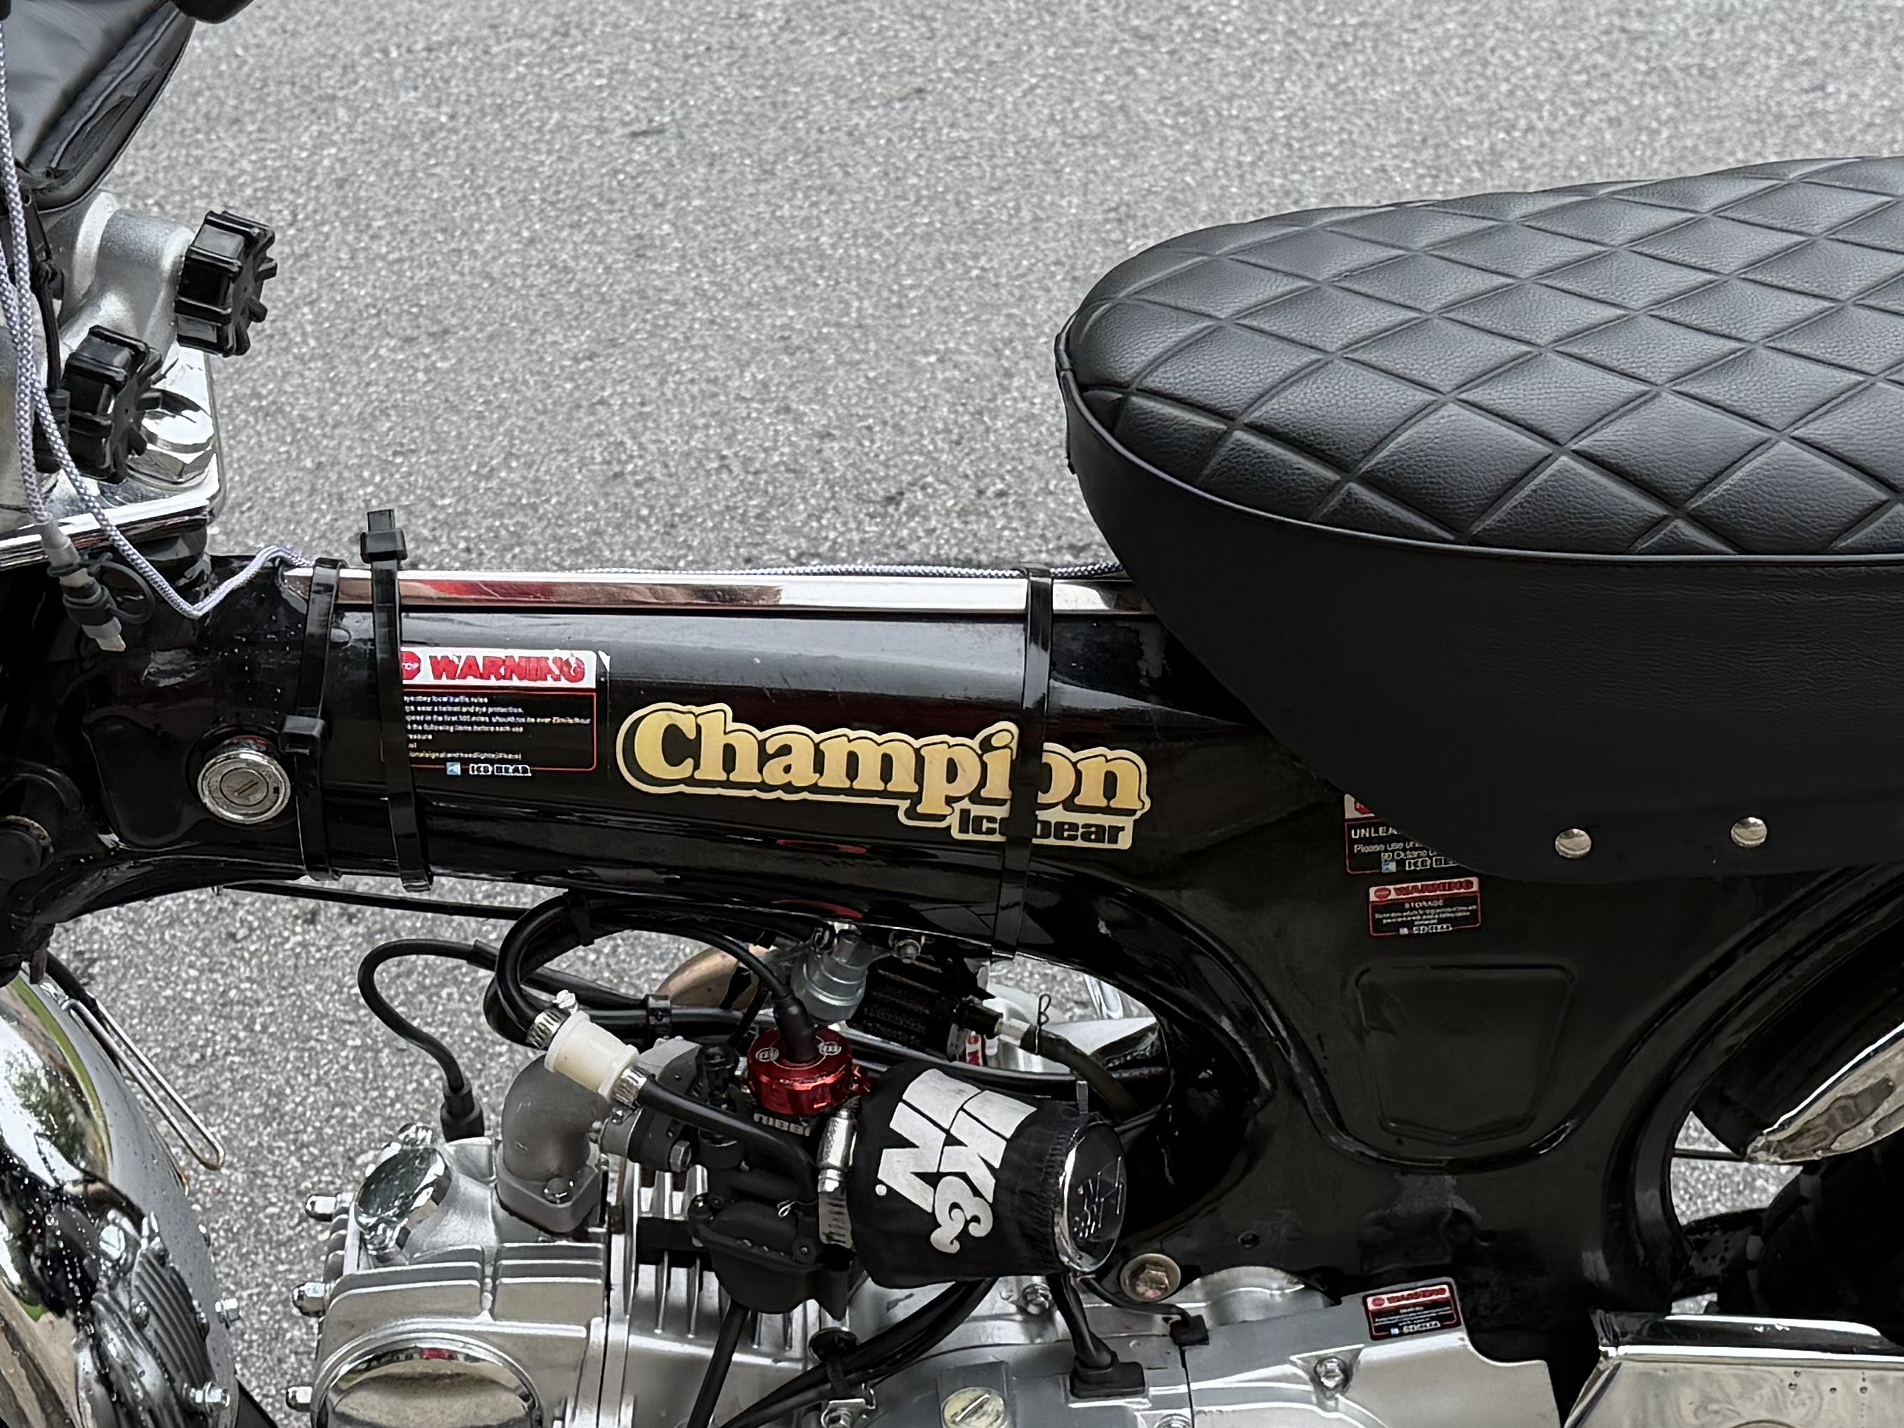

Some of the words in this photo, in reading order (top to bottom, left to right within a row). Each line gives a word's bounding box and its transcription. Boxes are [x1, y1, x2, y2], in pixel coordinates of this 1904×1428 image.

[429, 653, 585, 682] WARNING
[634, 710, 1145, 815] Champion
[1351, 826, 1398, 839] UNLEA
